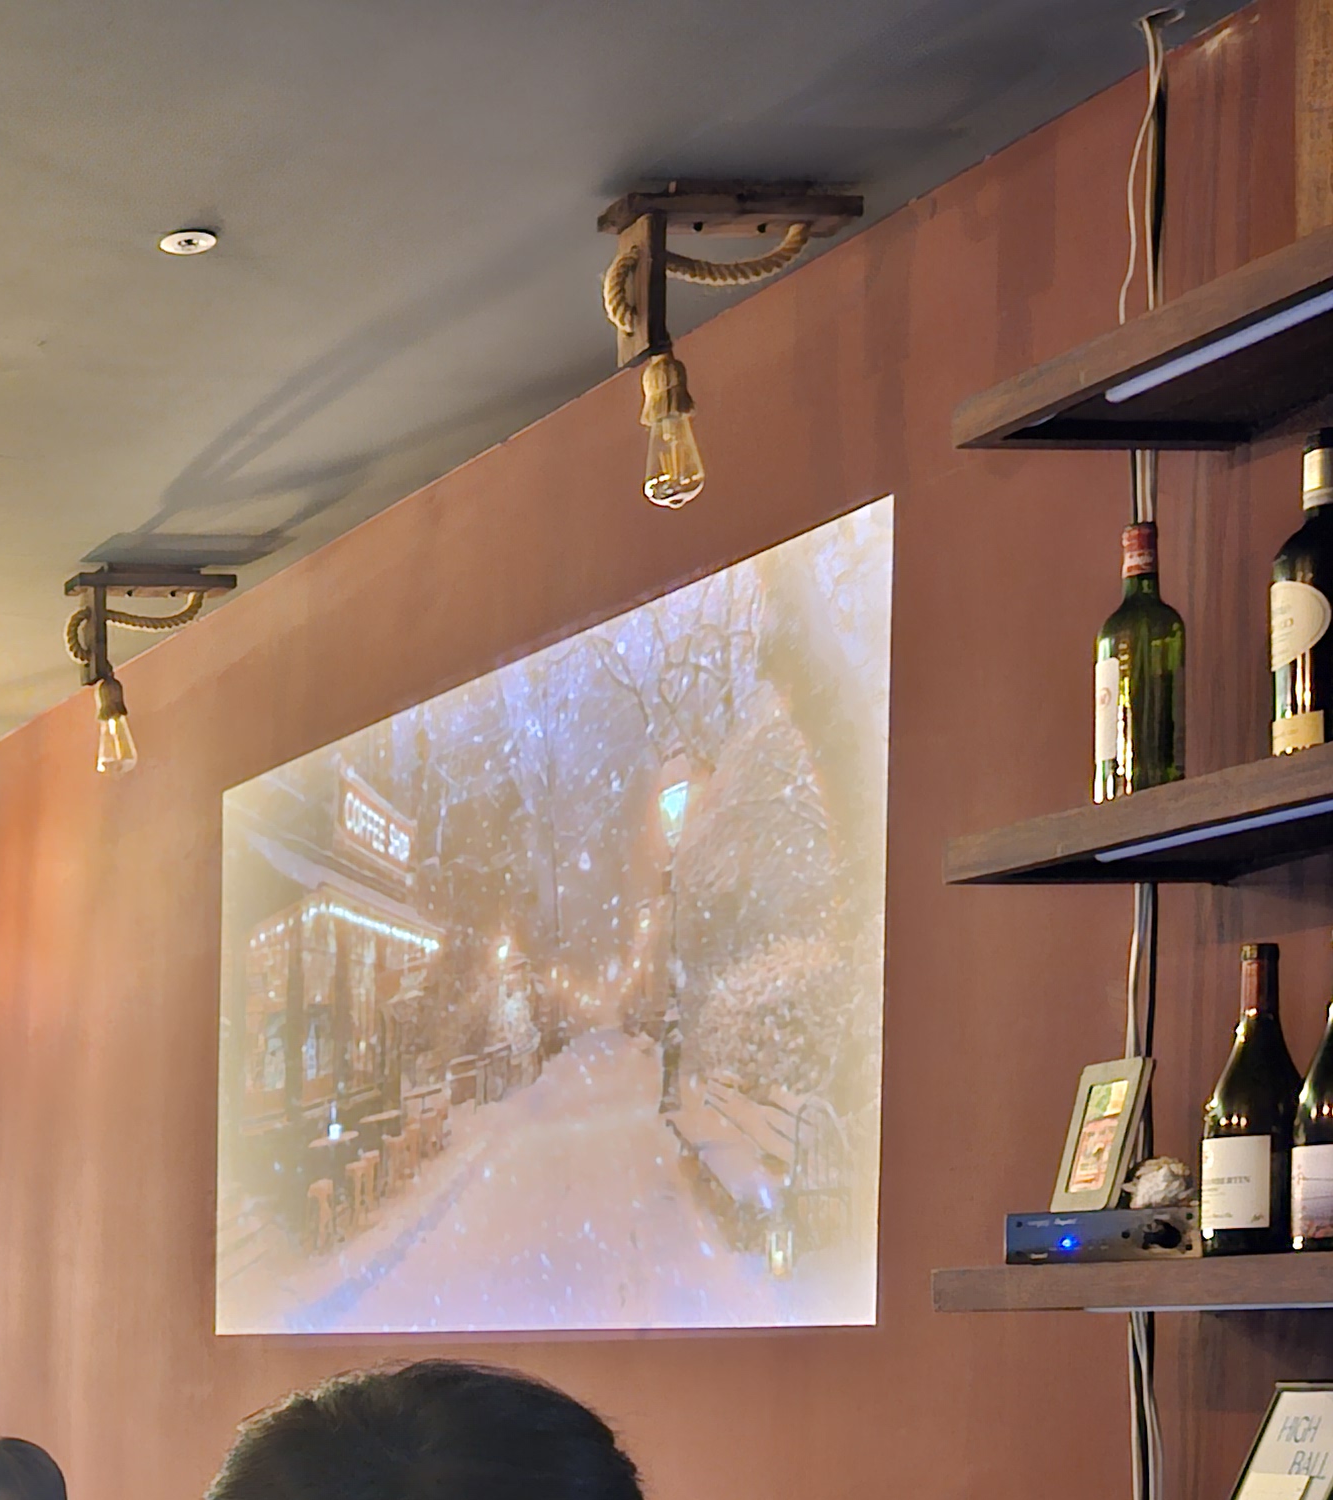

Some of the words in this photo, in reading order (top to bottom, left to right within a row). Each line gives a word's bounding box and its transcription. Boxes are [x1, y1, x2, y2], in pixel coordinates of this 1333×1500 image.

[344, 791, 386, 854] COFFEE
[1276, 1415, 1323, 1443] HIGH
[1287, 1450, 1329, 1480] BALL
